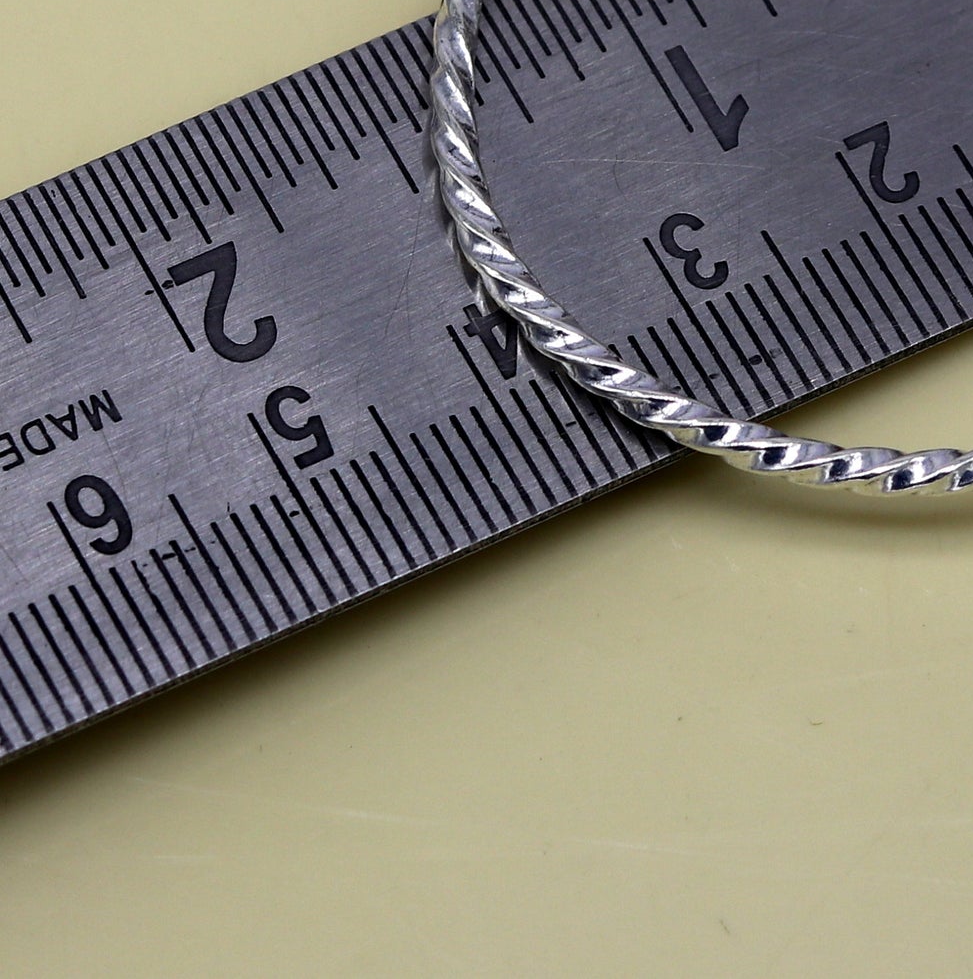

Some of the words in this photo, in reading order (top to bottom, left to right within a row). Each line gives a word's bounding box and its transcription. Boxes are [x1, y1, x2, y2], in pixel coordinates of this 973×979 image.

[664, 45, 750, 151] 1
[843, 121, 920, 203] 2
[659, 212, 729, 289] 3
[167, 241, 277, 363] 2
[462, 303, 519, 380] 4
[0, 389, 123, 471] MADE
[265, 385, 335, 469] 5
[64, 474, 133, 555] 6
